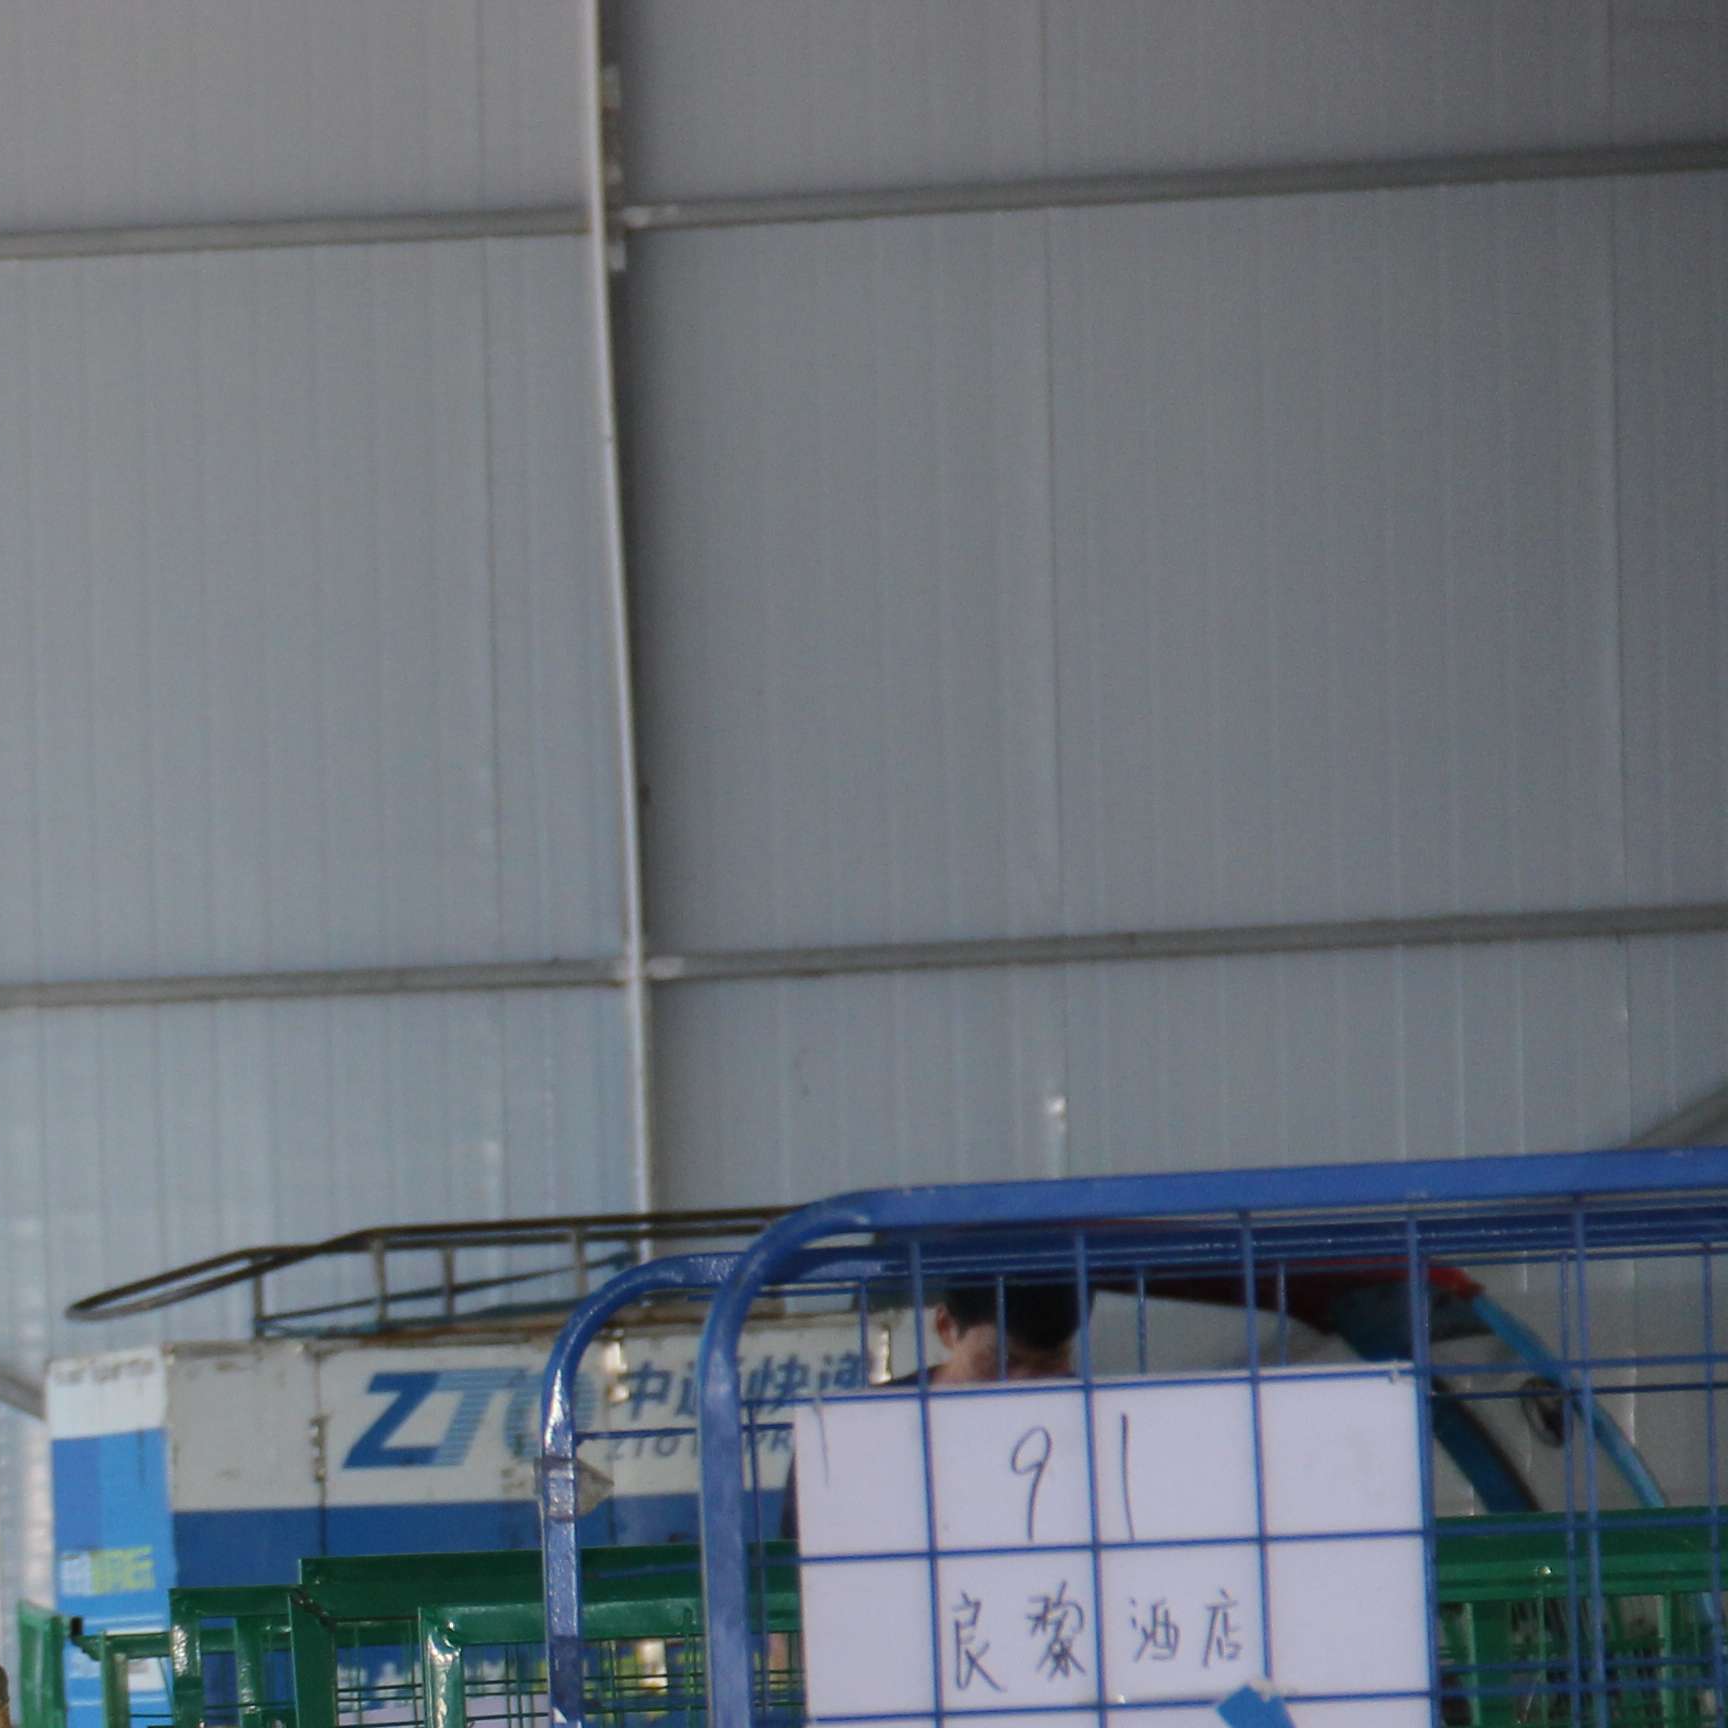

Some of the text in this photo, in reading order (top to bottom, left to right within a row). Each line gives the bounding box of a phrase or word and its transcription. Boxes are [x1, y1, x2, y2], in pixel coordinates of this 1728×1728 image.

[342, 1367, 600, 1471] ZTO
[621, 1350, 862, 1419] 中快递
